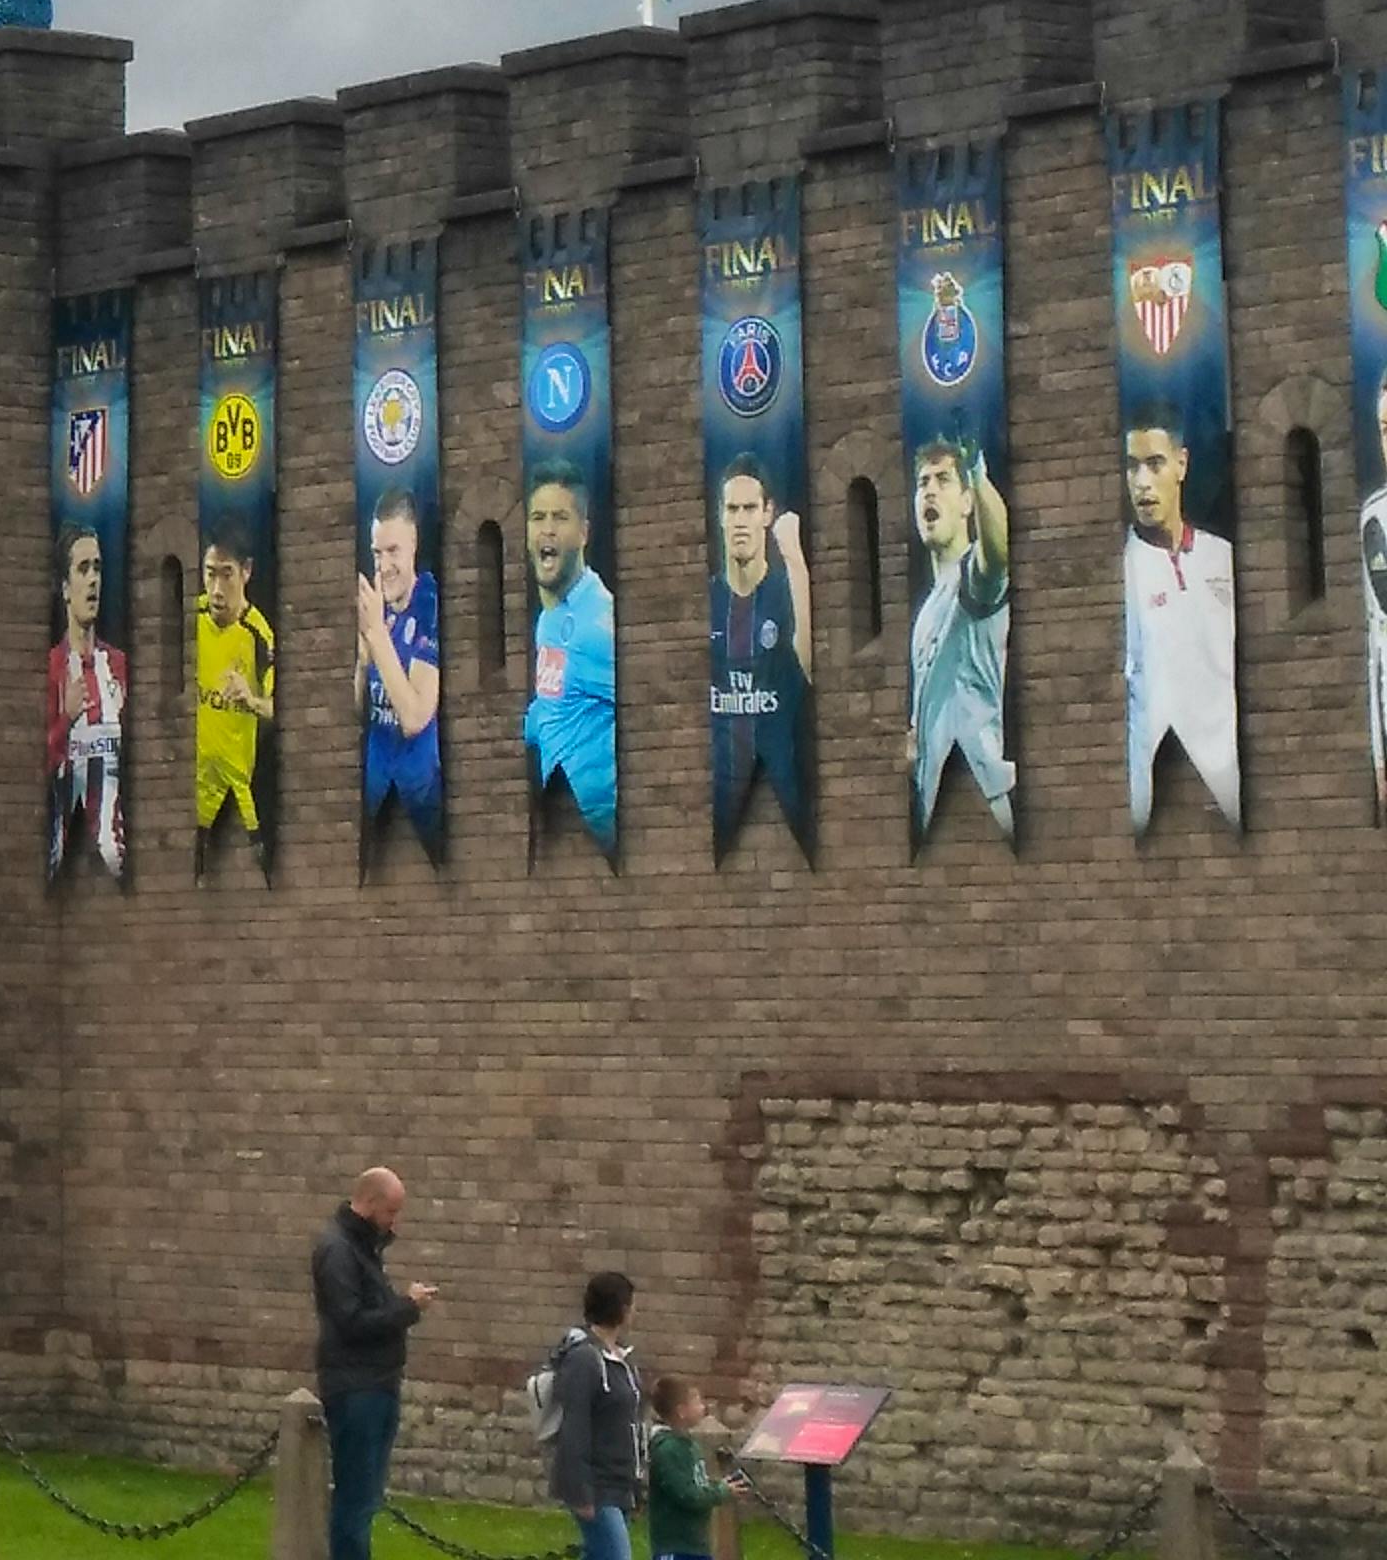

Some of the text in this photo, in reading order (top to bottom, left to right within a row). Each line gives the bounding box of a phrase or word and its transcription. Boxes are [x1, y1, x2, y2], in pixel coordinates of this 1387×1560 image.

[1111, 161, 1217, 210] FINAL
[900, 200, 995, 244] FINAL
[704, 235, 795, 277] FINAL
[356, 294, 434, 334] FINAL
[56, 338, 126, 377] FINAL
[201, 320, 272, 359] FINAL
[728, 671, 754, 690] Fly
[710, 686, 778, 715] Emirates
